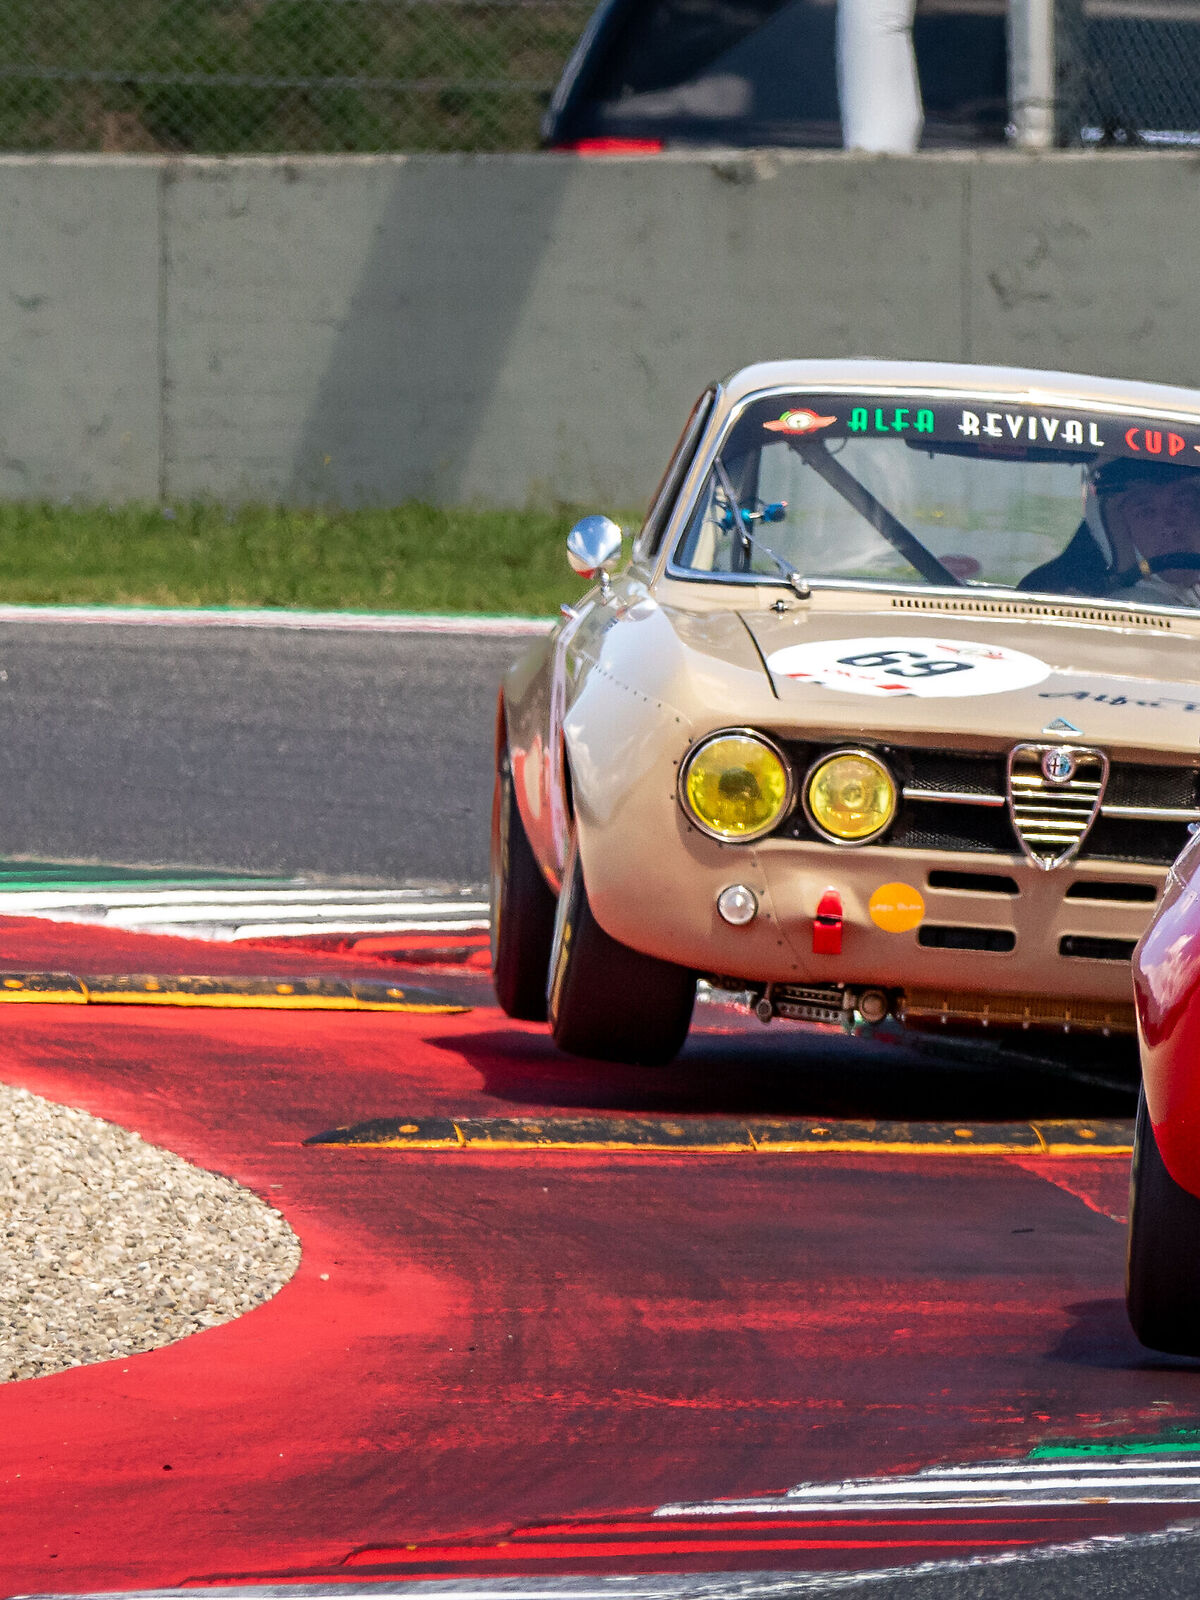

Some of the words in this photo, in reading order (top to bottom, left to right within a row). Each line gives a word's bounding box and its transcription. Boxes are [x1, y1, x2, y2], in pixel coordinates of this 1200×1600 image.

[847, 407, 935, 433] ALFA
[958, 411, 1105, 446] REVIVAL
[1125, 427, 1186, 456] CUP
[836, 651, 975, 677] 69
